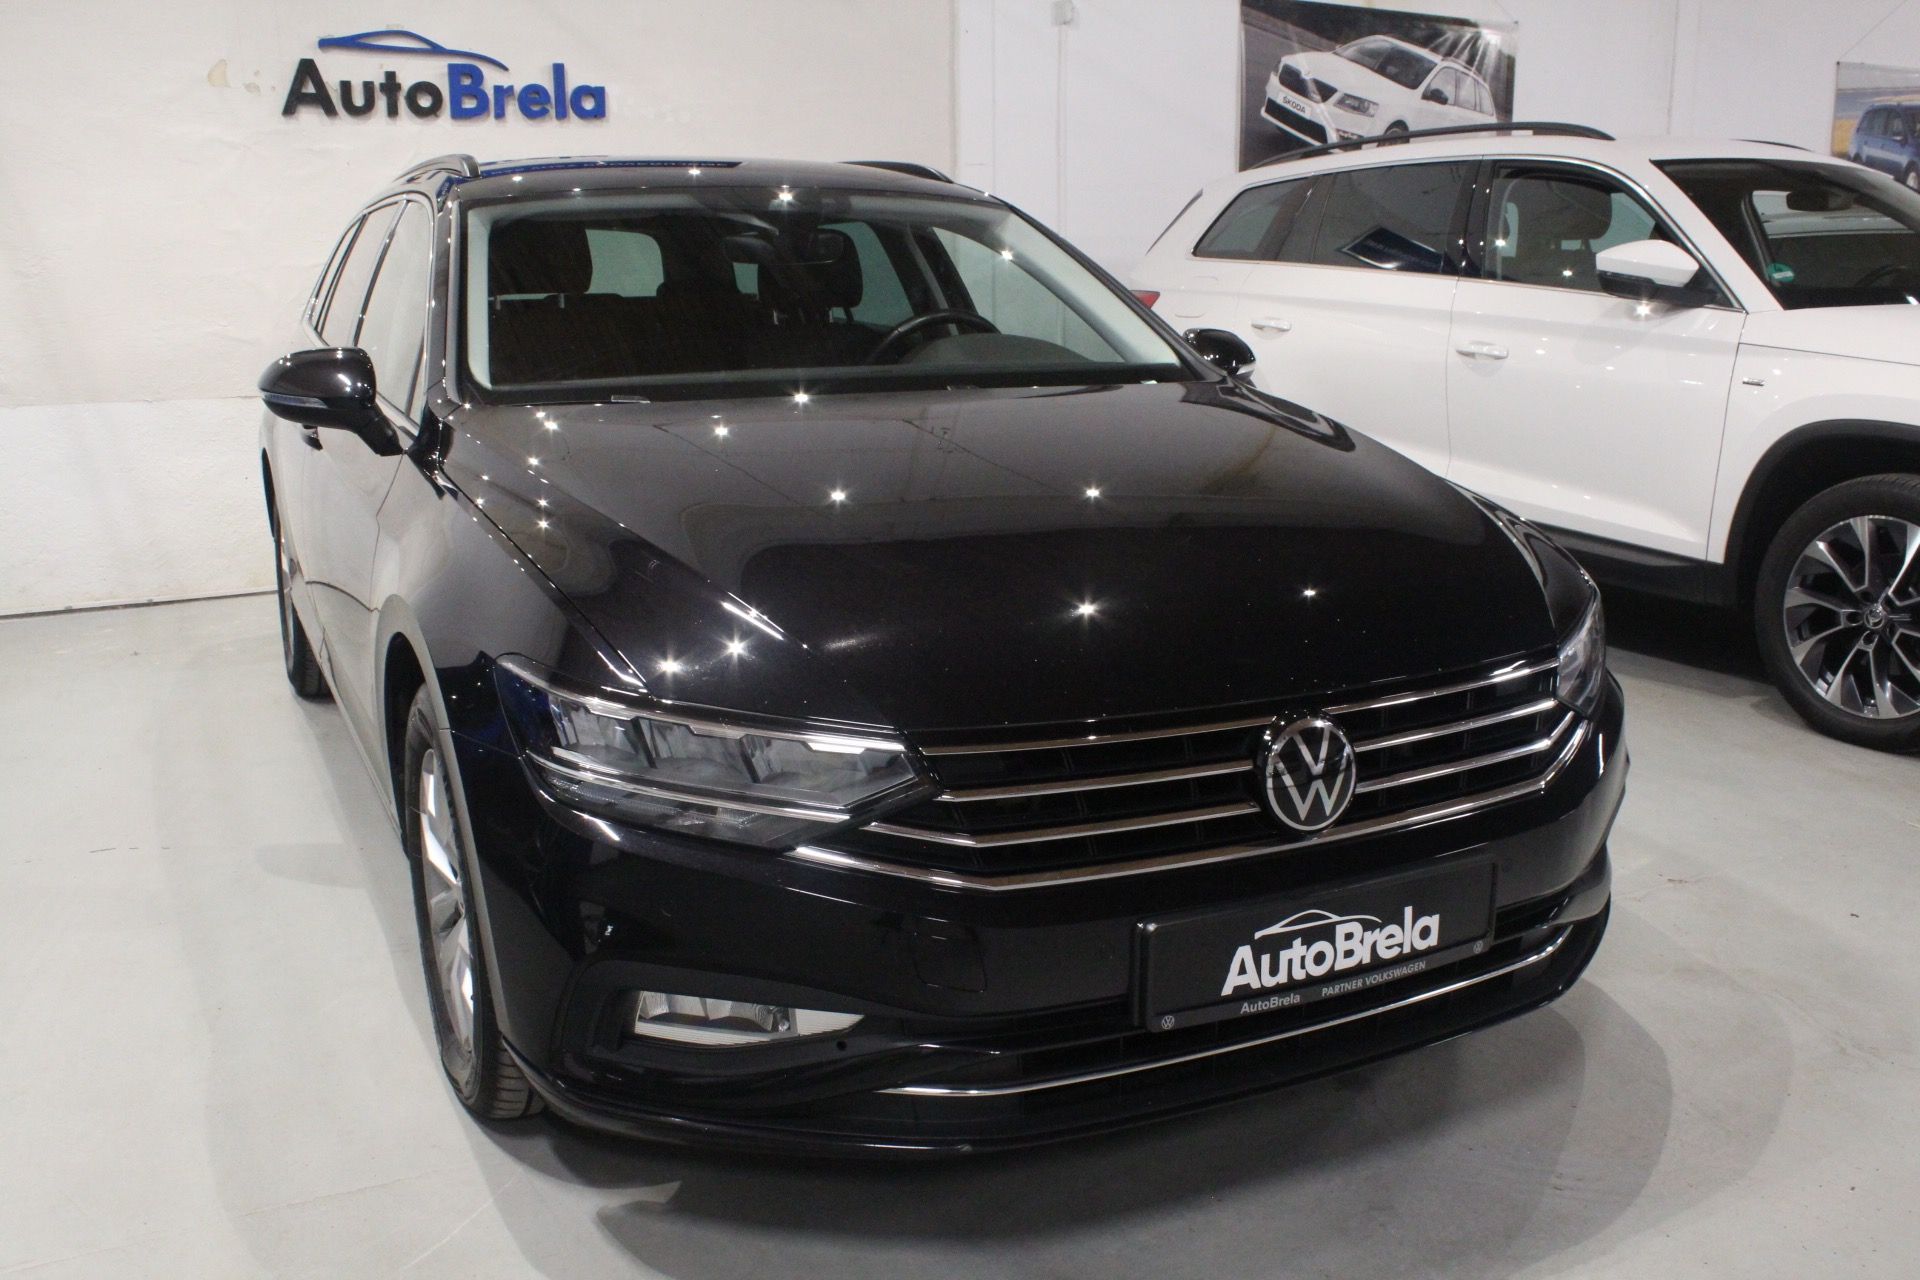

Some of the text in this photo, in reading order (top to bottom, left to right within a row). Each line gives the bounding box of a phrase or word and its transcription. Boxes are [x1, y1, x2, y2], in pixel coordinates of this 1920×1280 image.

[281, 58, 607, 120] AutoBrela
[1221, 906, 1440, 996] AutoBrela
[1240, 961, 1427, 1014] AutoBrela PARTNER VOLKSWAGEN
